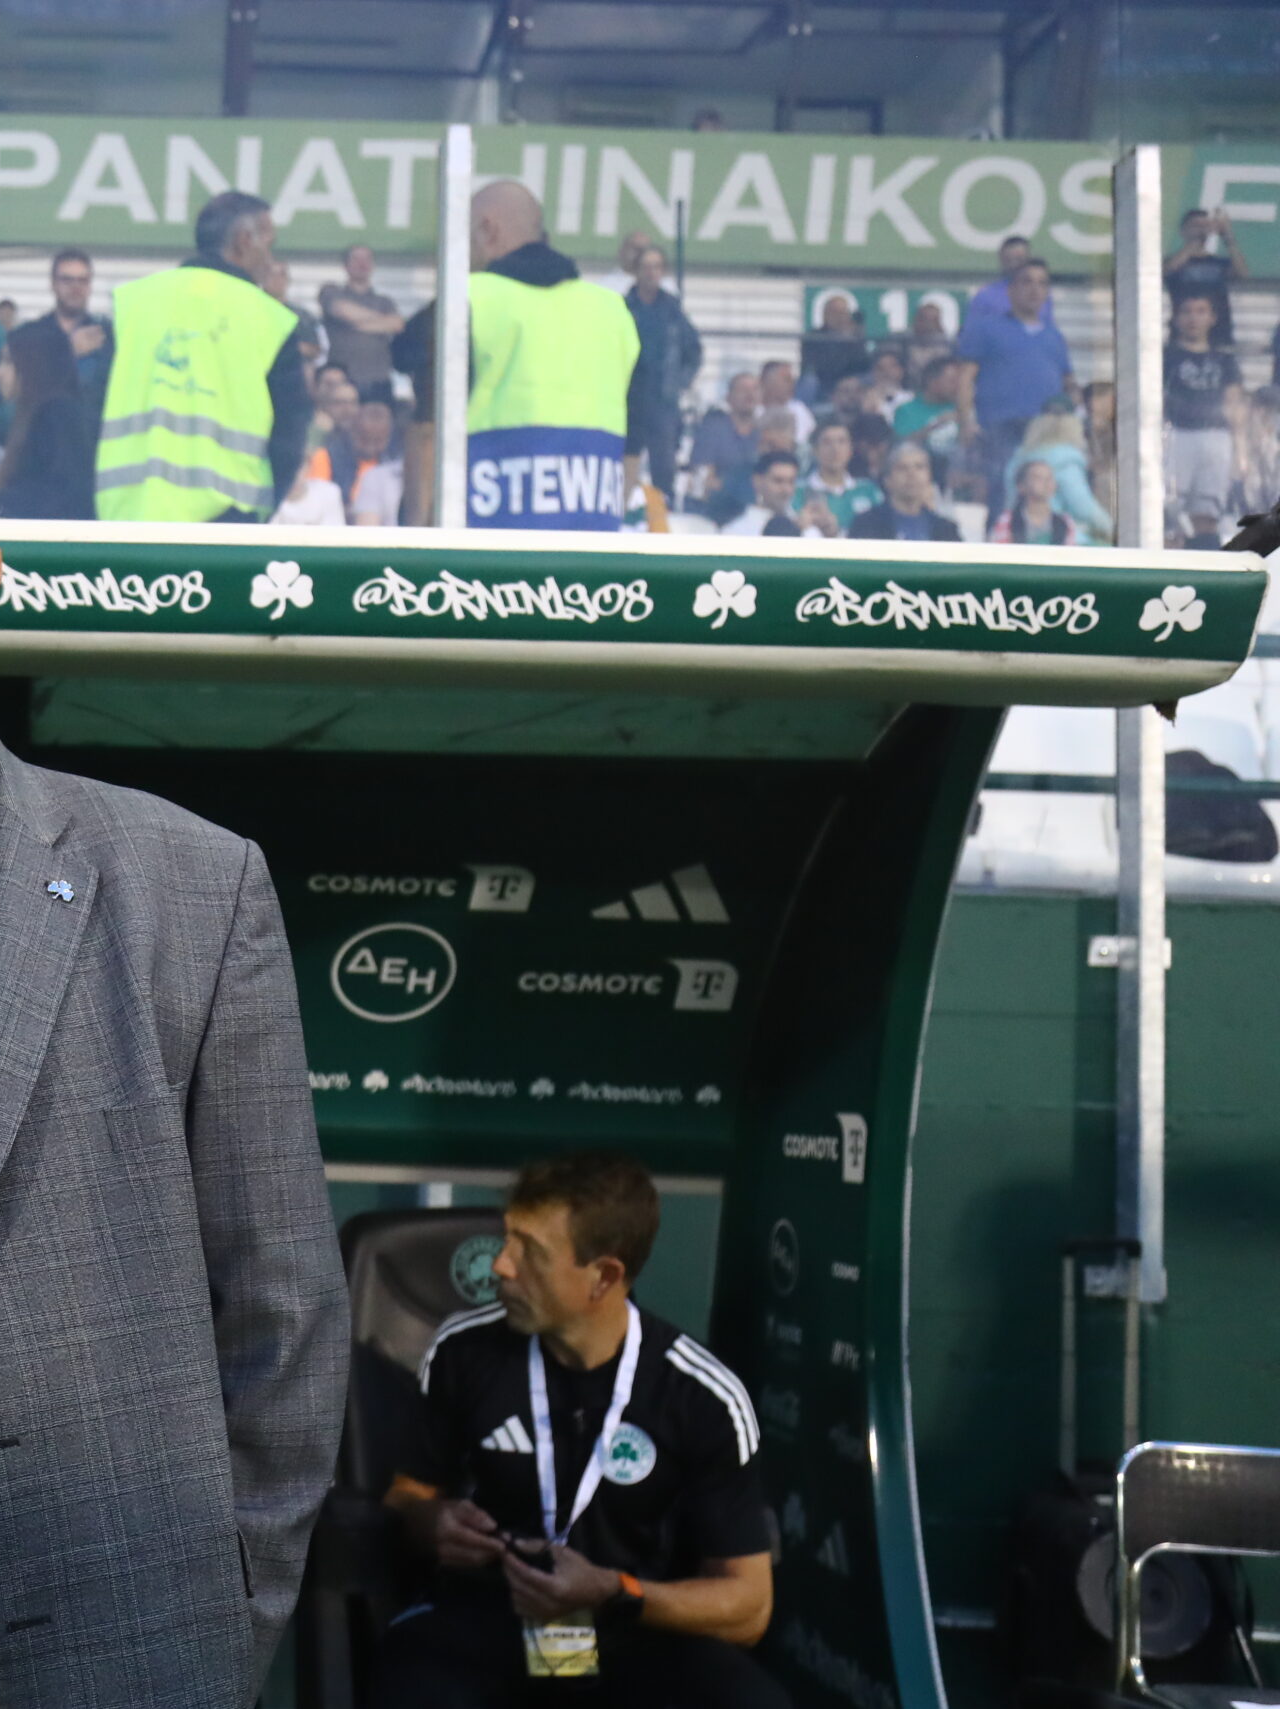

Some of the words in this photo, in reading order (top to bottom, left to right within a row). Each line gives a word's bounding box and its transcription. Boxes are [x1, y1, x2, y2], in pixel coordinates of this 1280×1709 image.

[471, 454, 625, 518] STEWA
[352, 566, 654, 624] @BORNIN1908
[794, 576, 1100, 635] @BORNIN1908
[307, 873, 458, 897] COSMOTE
[345, 946, 437, 995] ΔΕΗ
[517, 971, 664, 996] COSMOTE
